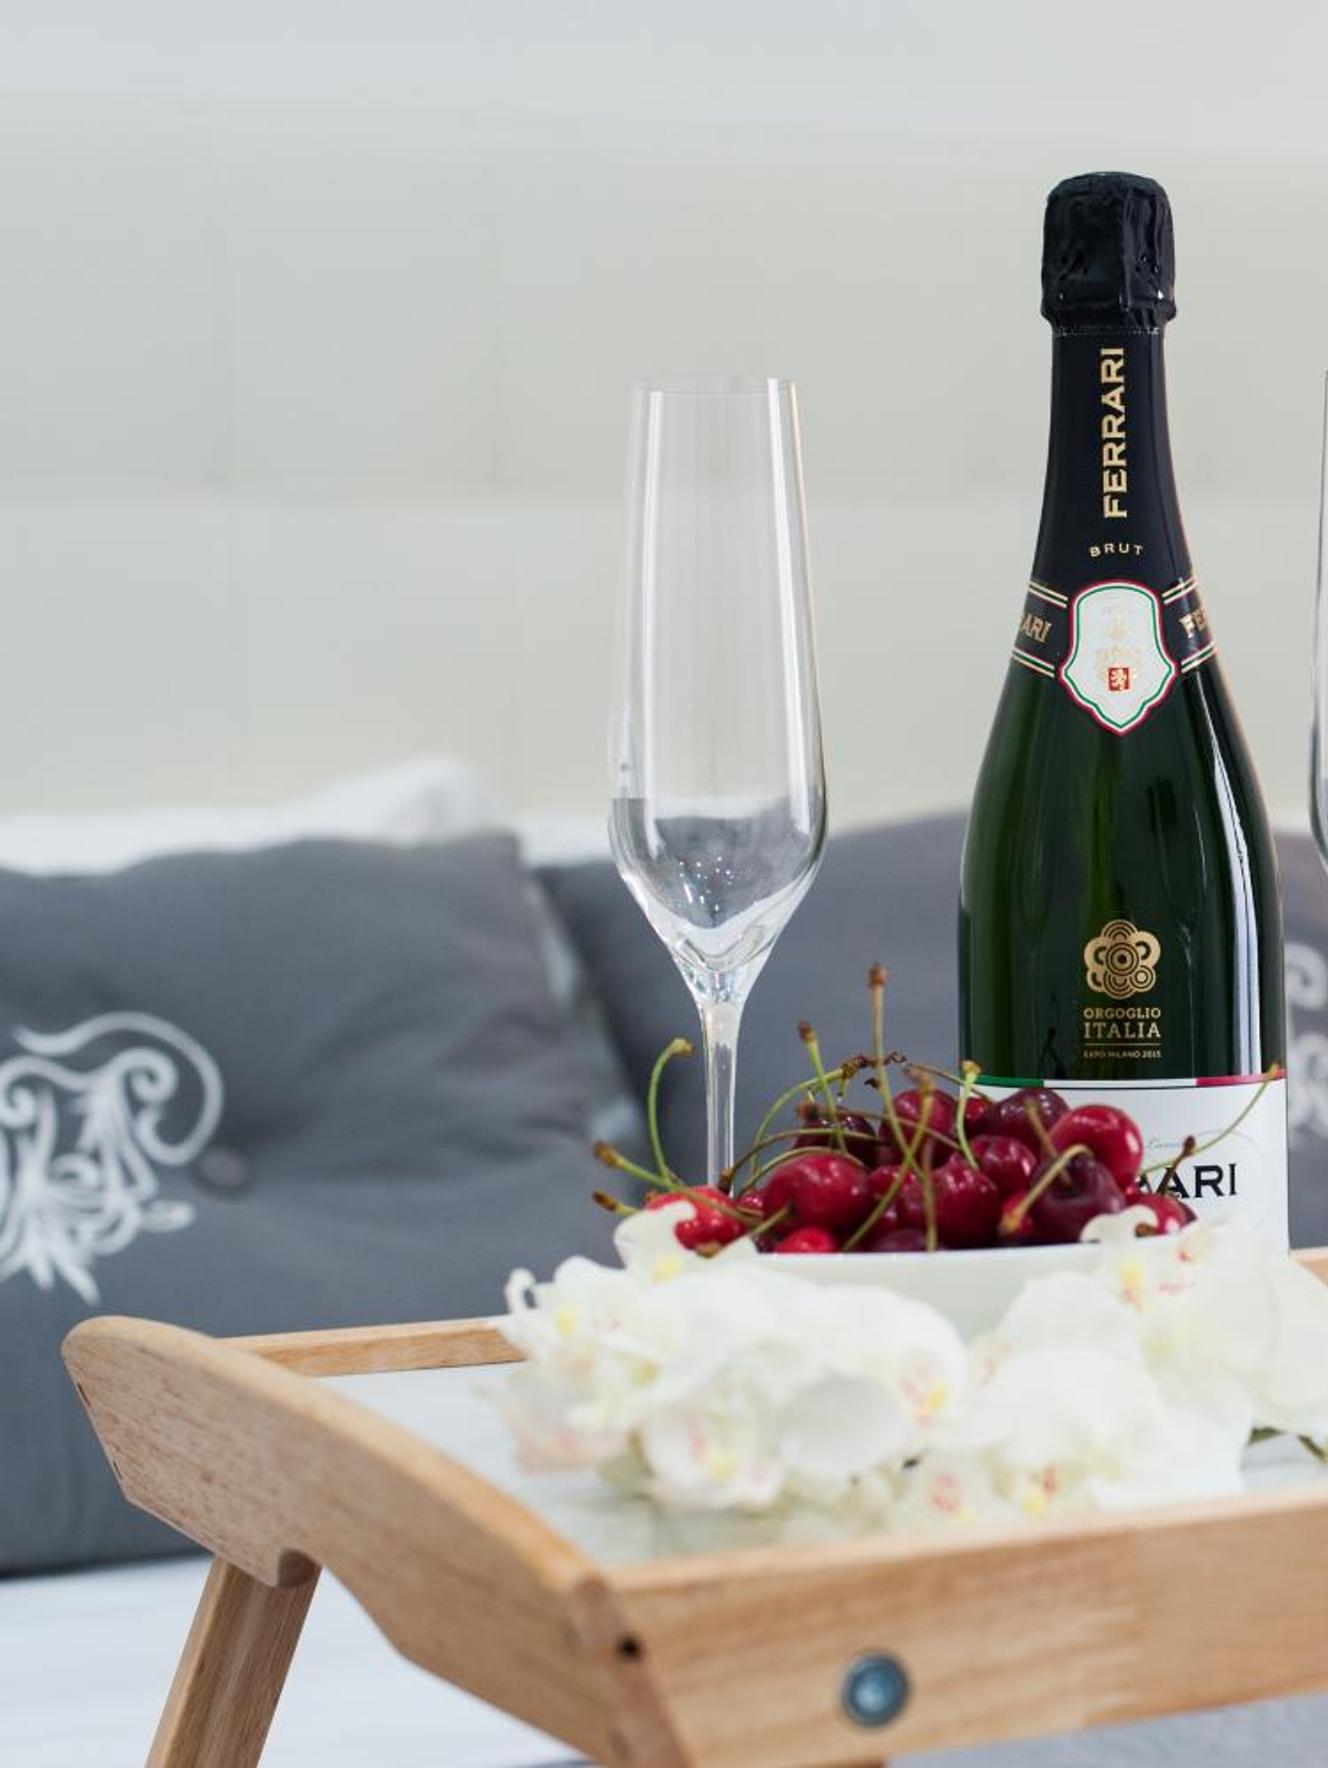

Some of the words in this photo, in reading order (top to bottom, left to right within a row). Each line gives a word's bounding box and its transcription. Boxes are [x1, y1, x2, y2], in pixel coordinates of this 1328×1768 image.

[1101, 348, 1128, 518] FERRARI
[1089, 543, 1143, 557] BRUT
[1021, 613, 1051, 643] ARI
[1083, 1007, 1161, 1019] ORGOGLIO
[1083, 1022, 1161, 1038] ITALIA
